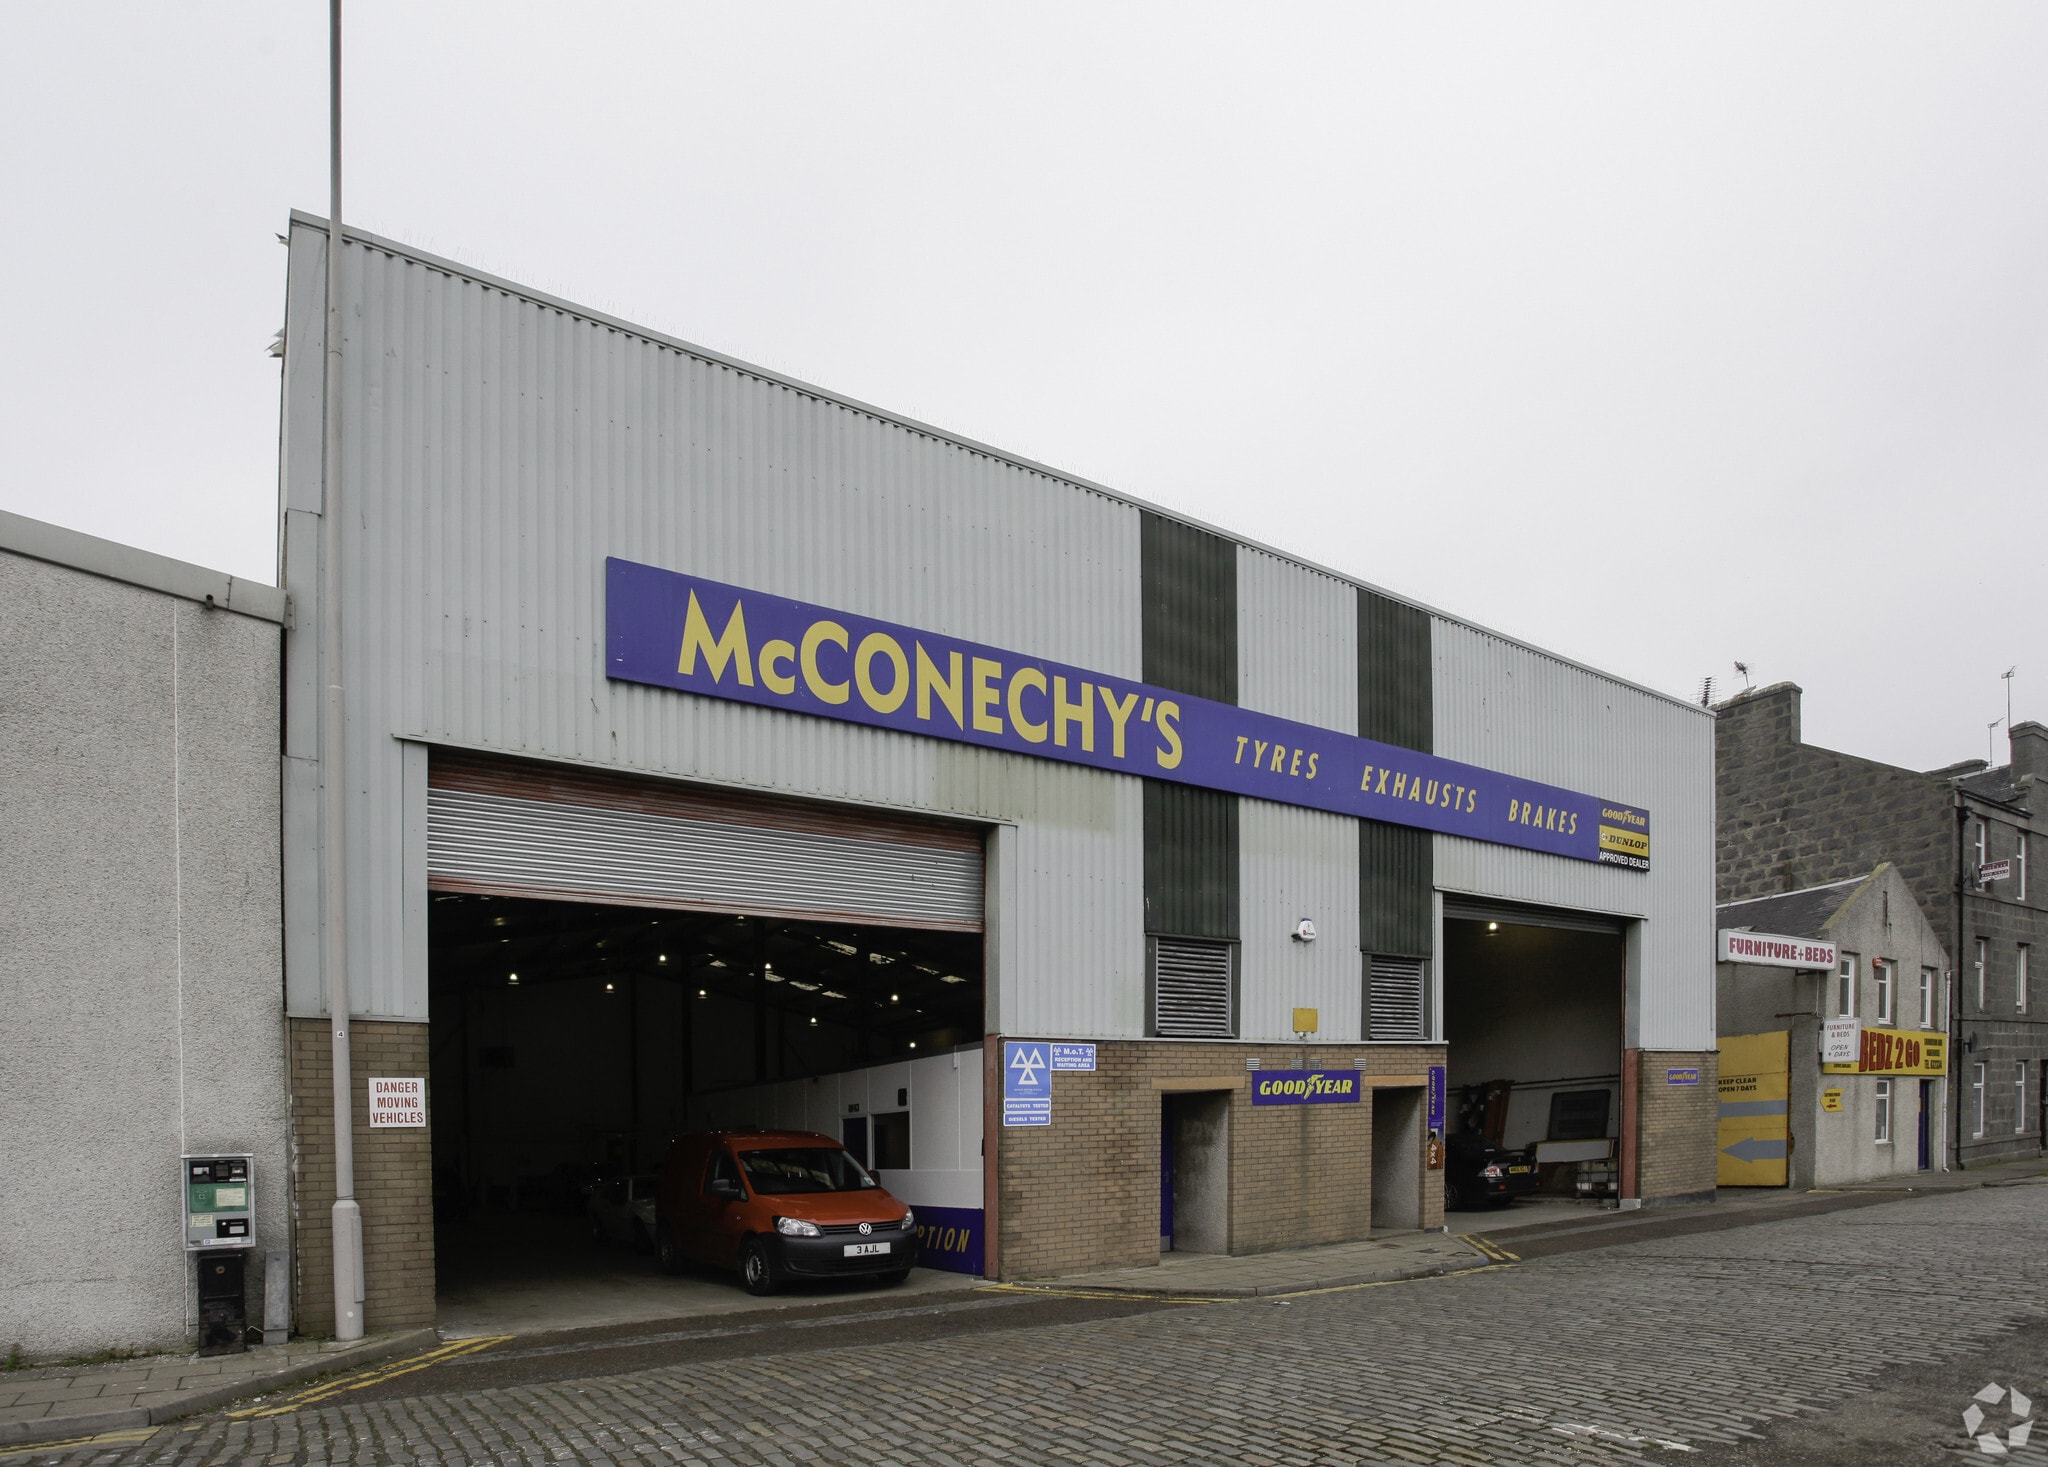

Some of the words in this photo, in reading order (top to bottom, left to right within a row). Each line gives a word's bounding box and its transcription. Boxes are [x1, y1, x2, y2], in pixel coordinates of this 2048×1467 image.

[677, 588, 1183, 770] McCONECHY'S
[1234, 736, 1319, 780] TYRES
[1360, 765, 1477, 813] EXHAUSTS
[1508, 798, 1578, 835] BRAKES
[1602, 808, 1646, 826] GOODYEAR
[1609, 835, 1647, 850] DUNLOP
[1599, 851, 1629, 865] APPROVED
[1629, 856, 1649, 869] DEALER
[1827, 1023, 1855, 1031] FURNITURE
[1859, 1029, 1893, 1072] BEDZ
[1895, 1037, 1904, 1069] 2
[1906, 1038, 1920, 1068] GO
[1669, 1071, 1697, 1081] GOODYEAR
[376, 1081, 418, 1093] DANGER
[1259, 1074, 1353, 1100] GOODYEAR
[377, 1096, 418, 1108] MOVING
[372, 1111, 424, 1124] VEHICLES
[856, 1245, 862, 1255] 3
[864, 1244, 880, 1254] AJL
